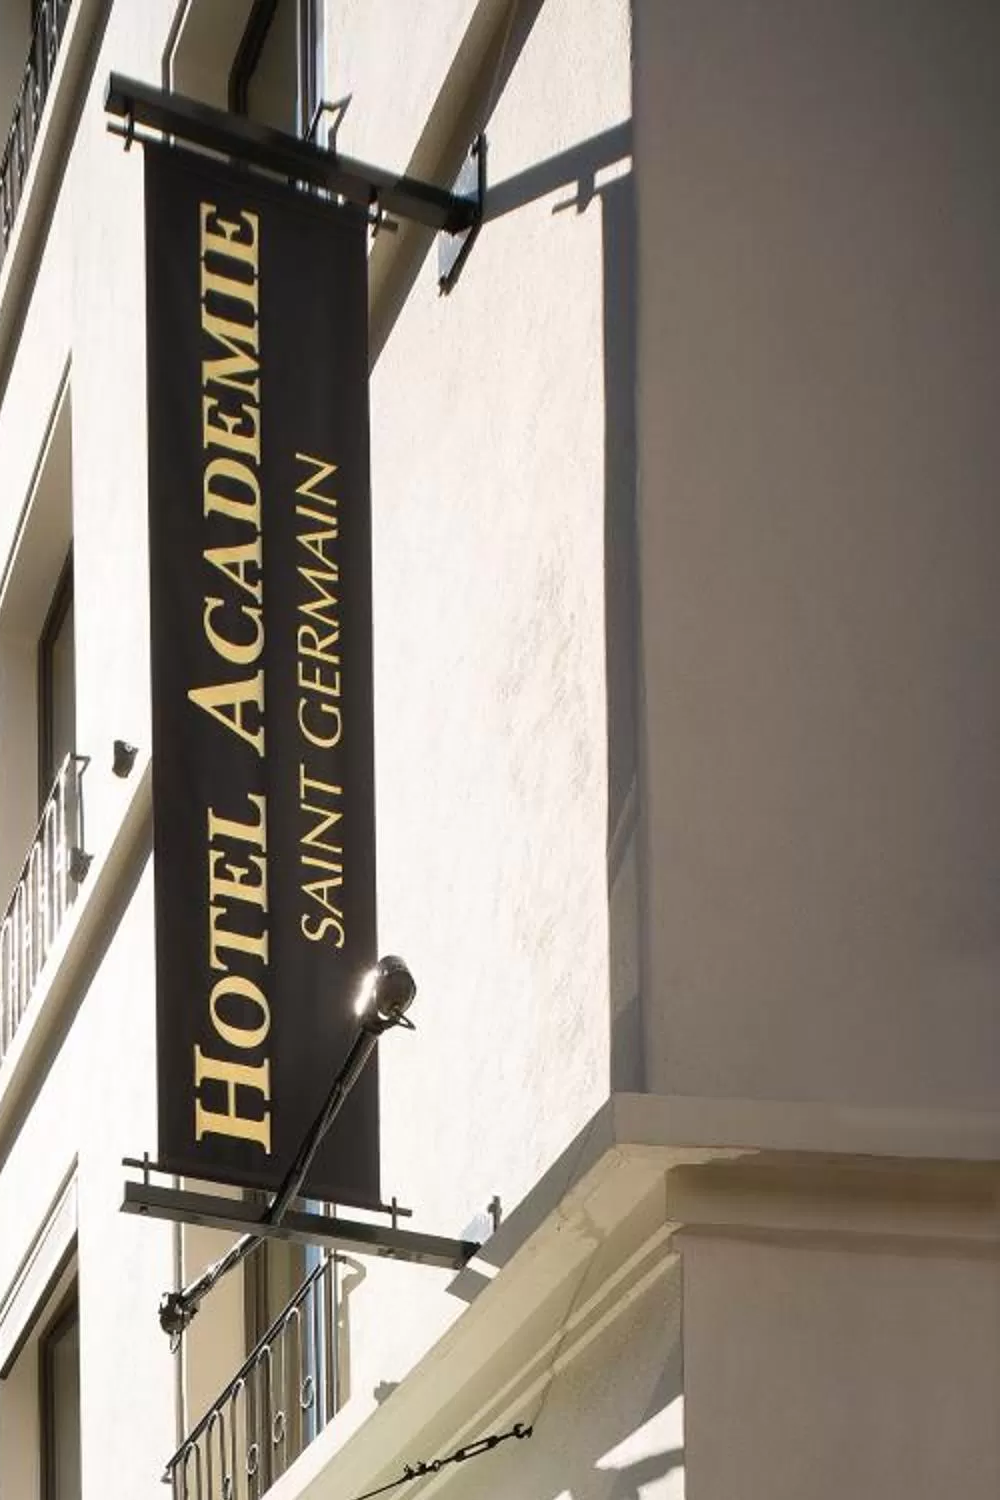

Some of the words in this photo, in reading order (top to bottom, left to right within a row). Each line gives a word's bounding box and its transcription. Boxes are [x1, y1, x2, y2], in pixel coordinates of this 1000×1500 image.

[187, 202, 266, 757] ACADEMIE
[295, 452, 343, 749] GERMAIN
[194, 793, 272, 1155] HOTEL
[300, 763, 345, 948] SAINT
